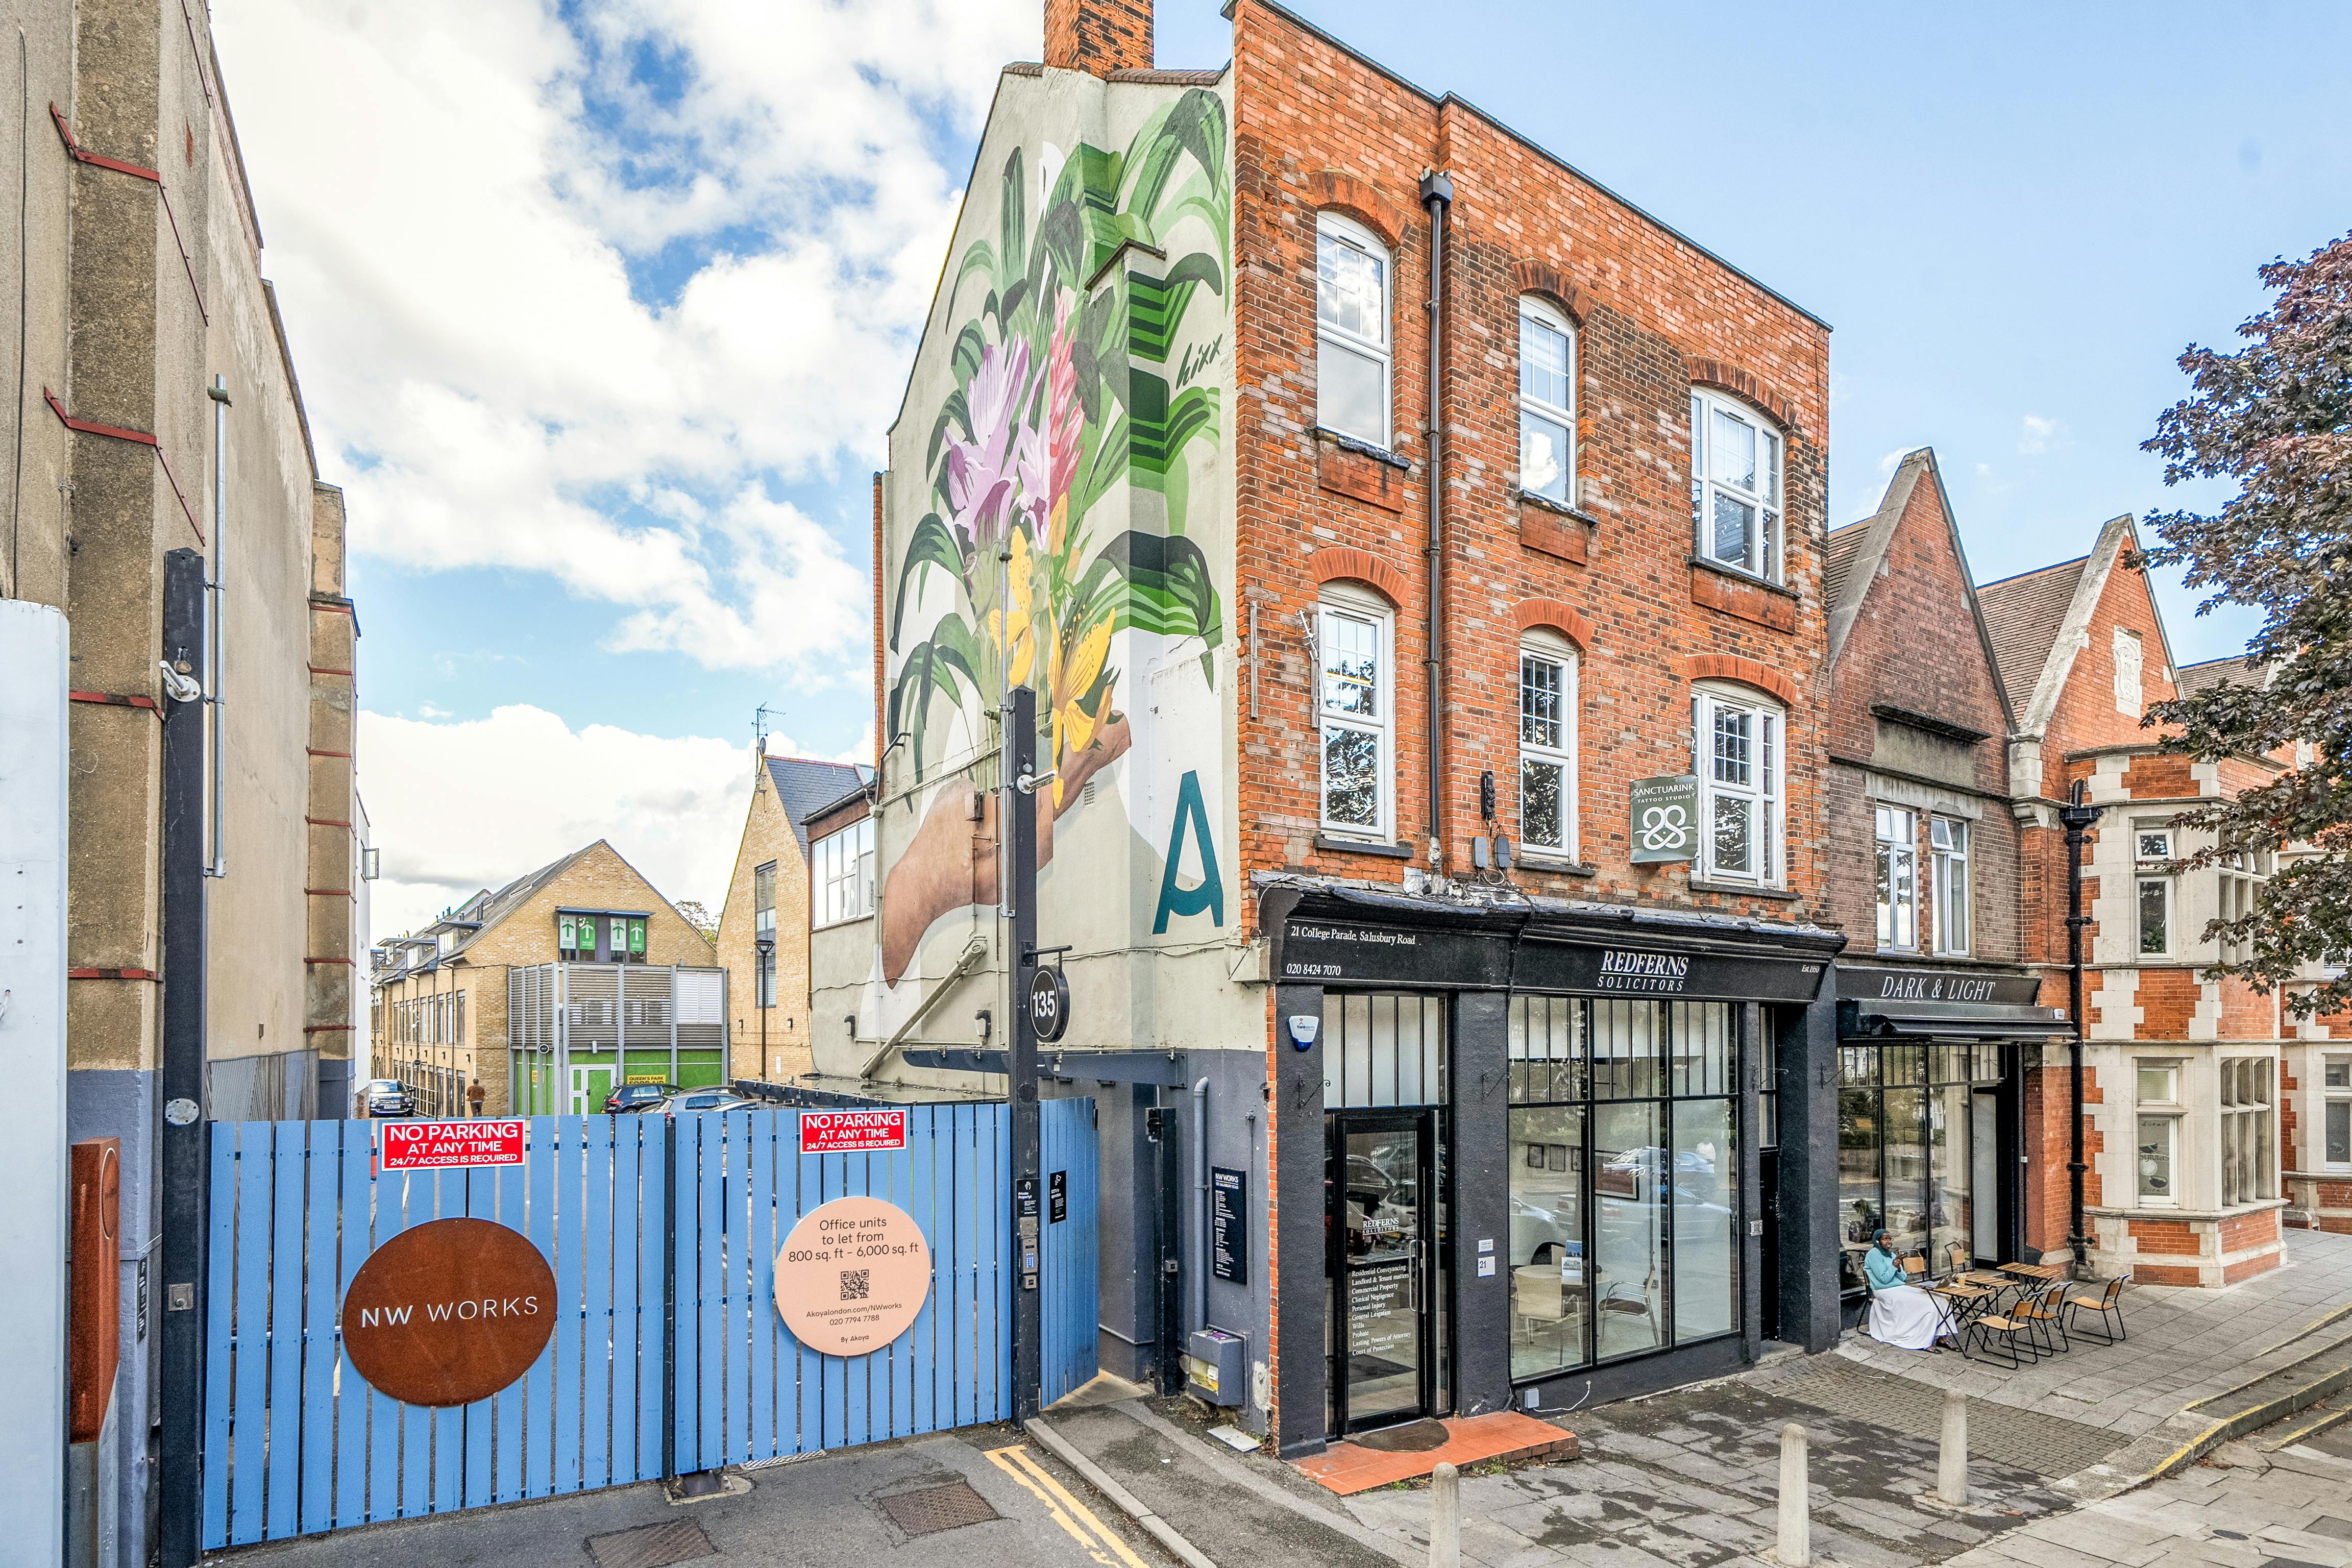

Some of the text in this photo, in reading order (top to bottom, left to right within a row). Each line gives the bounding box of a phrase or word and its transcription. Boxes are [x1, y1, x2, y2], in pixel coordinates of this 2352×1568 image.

[1634, 783, 1694, 796] SANCTUARINK
[1152, 770, 1223, 935] A
[1291, 926, 1415, 945] 21 College Parade, Salusbury Road
[1287, 963, 1341, 975] 020 8424 7070
[1601, 951, 1689, 976] REDFERNS
[1598, 976, 1683, 991] SOLICITORS
[1881, 976, 1996, 1000] DARK & LIGHT
[1033, 990, 1056, 1018] 135
[806, 1113, 900, 1129] NO PARKING
[390, 1123, 518, 1141] NO PARKING
[819, 1128, 889, 1140] AT ANY TIME
[407, 1141, 503, 1155] AT ANY TIME
[806, 1141, 826, 1149] 24/7
[827, 1141, 857, 1149] ACCESS
[866, 1139, 900, 1147] REQUIRED
[390, 1154, 518, 1166] 24/7 ACCESS IS REQUIRED
[1223, 1174, 1239, 1183] WORKS
[820, 1217, 887, 1231] Office units
[1363, 1217, 1399, 1228] REDFERNS
[822, 1232, 884, 1245] to let from
[789, 1251, 813, 1262] 800
[815, 1252, 831, 1262] sq.
[834, 1248, 843, 1259] ft
[857, 1245, 889, 1258] 6,000
[892, 1246, 907, 1256] sq.
[910, 1242, 919, 1253] ft
[1352, 1264, 1406, 1277] Residential Conveyancing
[1480, 1260, 1486, 1269] 21
[1352, 1278, 1371, 1286] Landlord
[1352, 1285, 1379, 1294] Commercial
[1352, 1295, 1369, 1303] Clinical
[361, 1296, 538, 1328] NW WORKS
[806, 1303, 902, 1318] Akoyalondon.com/NWworks
[1352, 1303, 1370, 1312] Personal
[1370, 1310, 1391, 1318] Litigation
[1373, 1343, 1394, 1352] Protection
